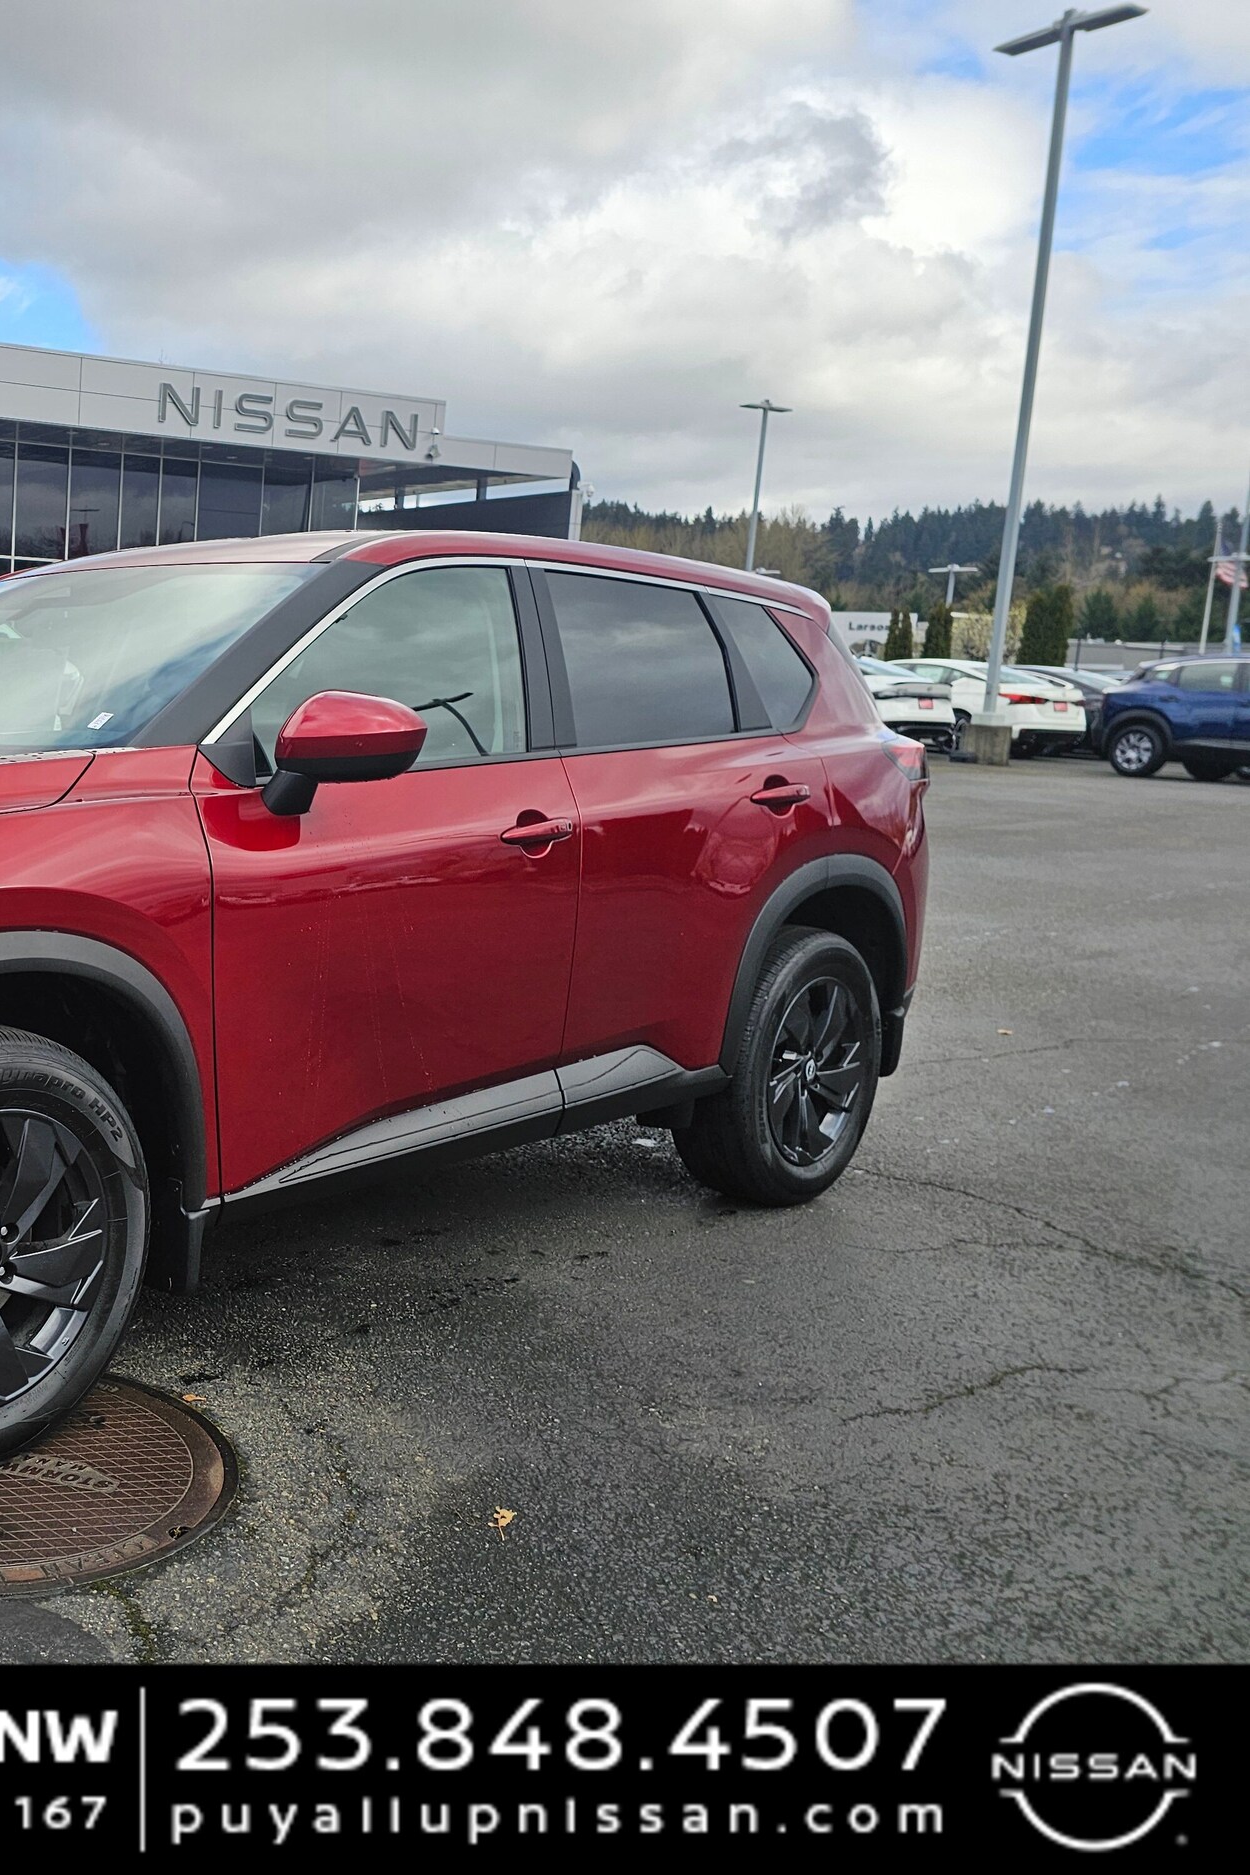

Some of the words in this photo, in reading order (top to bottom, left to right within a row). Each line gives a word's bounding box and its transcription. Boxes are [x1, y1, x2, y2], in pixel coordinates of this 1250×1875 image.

[158, 382, 418, 450] NISSAN
[88, 1097, 124, 1142] HP2
[23, 1454, 88, 1471] MANA
